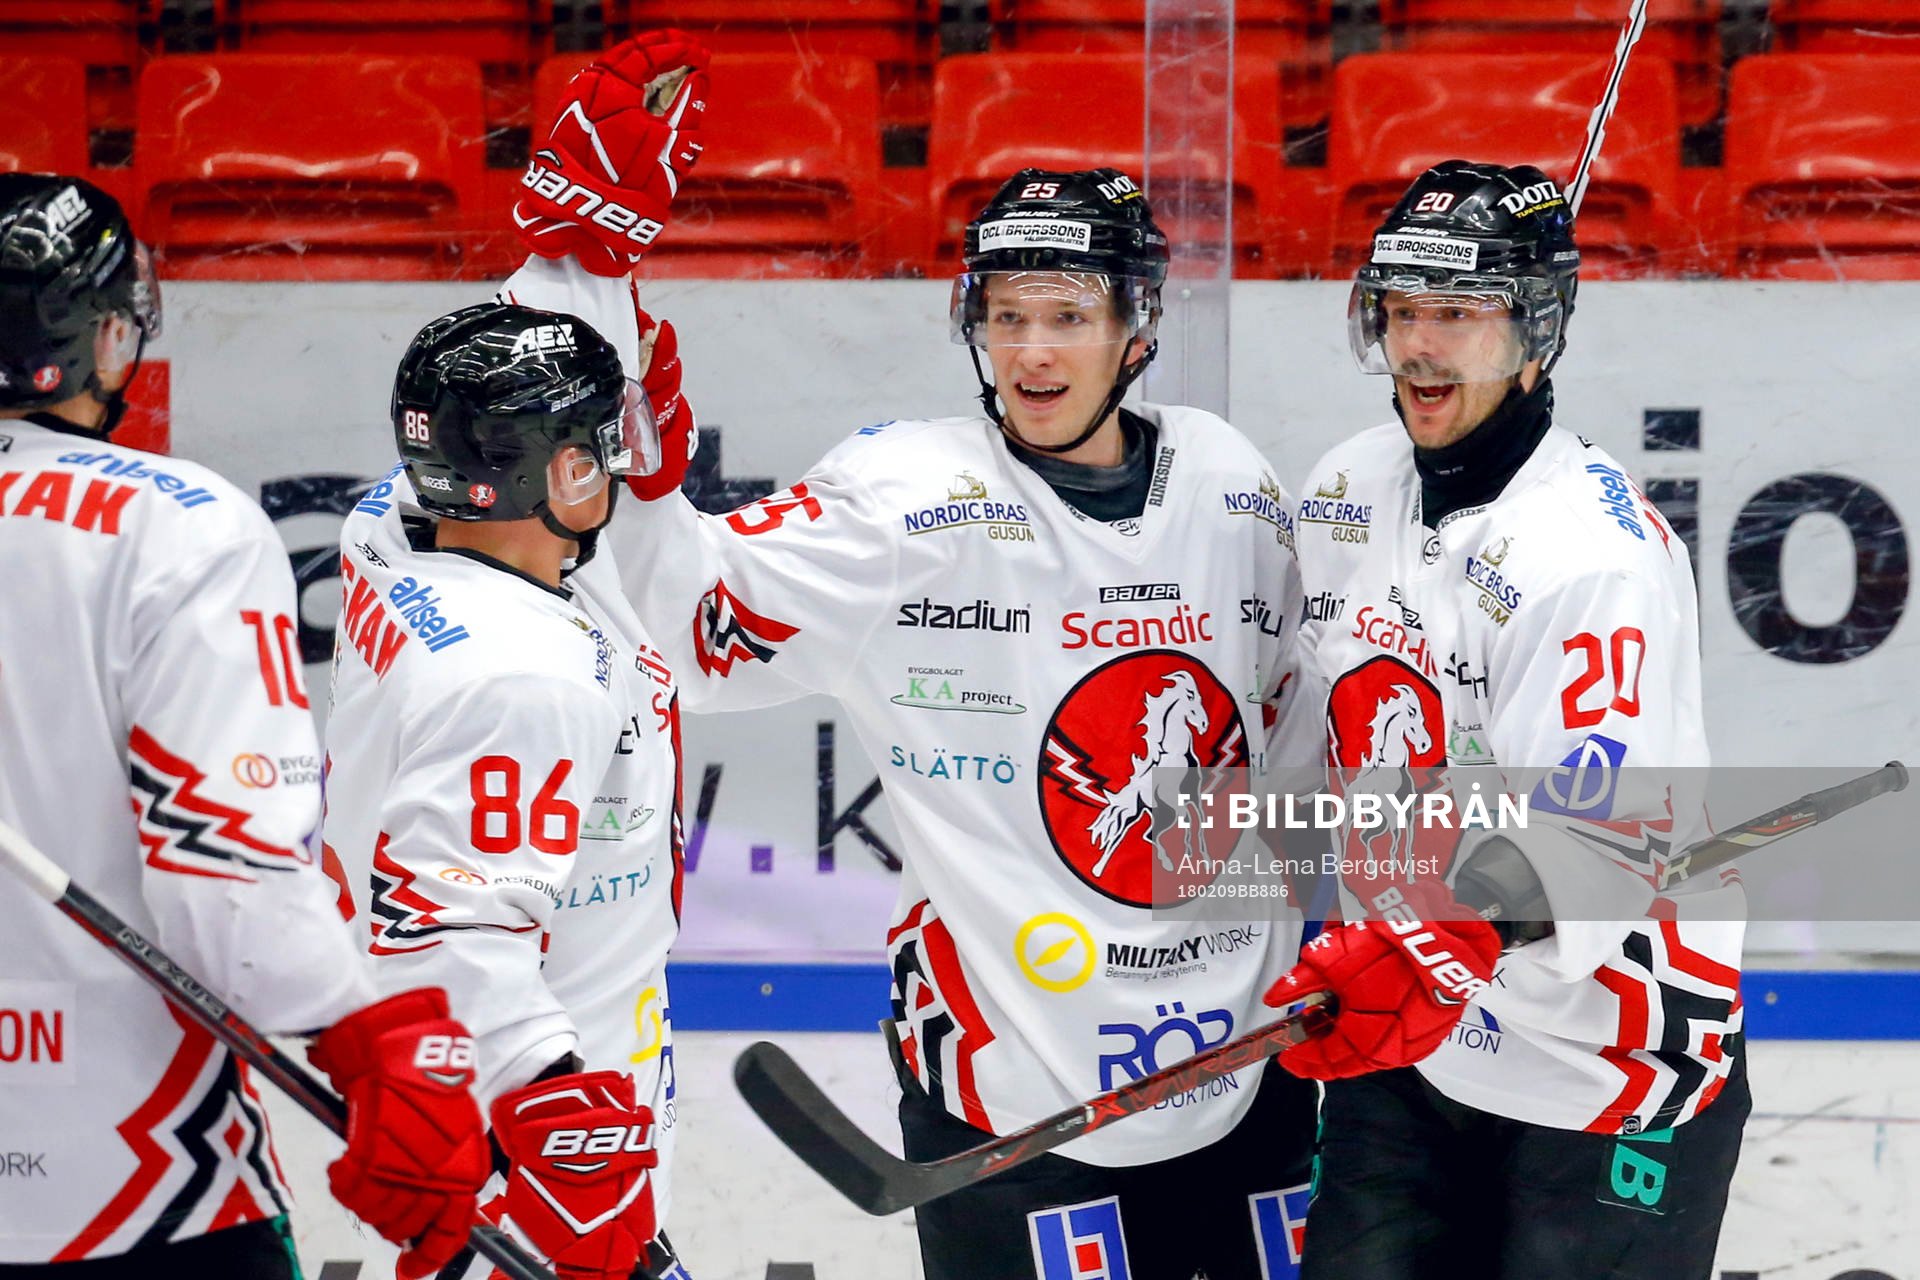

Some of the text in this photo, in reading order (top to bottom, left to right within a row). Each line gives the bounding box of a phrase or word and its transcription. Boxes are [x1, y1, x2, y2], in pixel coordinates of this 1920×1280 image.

[521, 160, 664, 245] BAUER
[1021, 183, 1060, 198] 25
[1415, 192, 1454, 212] 20
[1396, 240, 1473, 258] BRORSSONS
[510, 324, 577, 356] AEZ
[405, 410, 430, 442] 86
[1148, 447, 1176, 507] RINKSIDE
[904, 502, 981, 531] NORDIC
[1585, 463, 1647, 540] ahsell
[1102, 584, 1179, 602] BAUER
[389, 576, 470, 653] ahsell
[897, 598, 1030, 633] stadium
[1061, 604, 1213, 649] Scandic
[238, 608, 312, 710] 10
[907, 666, 964, 676] BYGGBOLAGET
[1560, 626, 1646, 730] 20
[961, 690, 1013, 705] project
[891, 745, 1015, 784] SLÄTTÖ
[470, 755, 580, 856] 86
[1372, 886, 1491, 1000] BAUER
